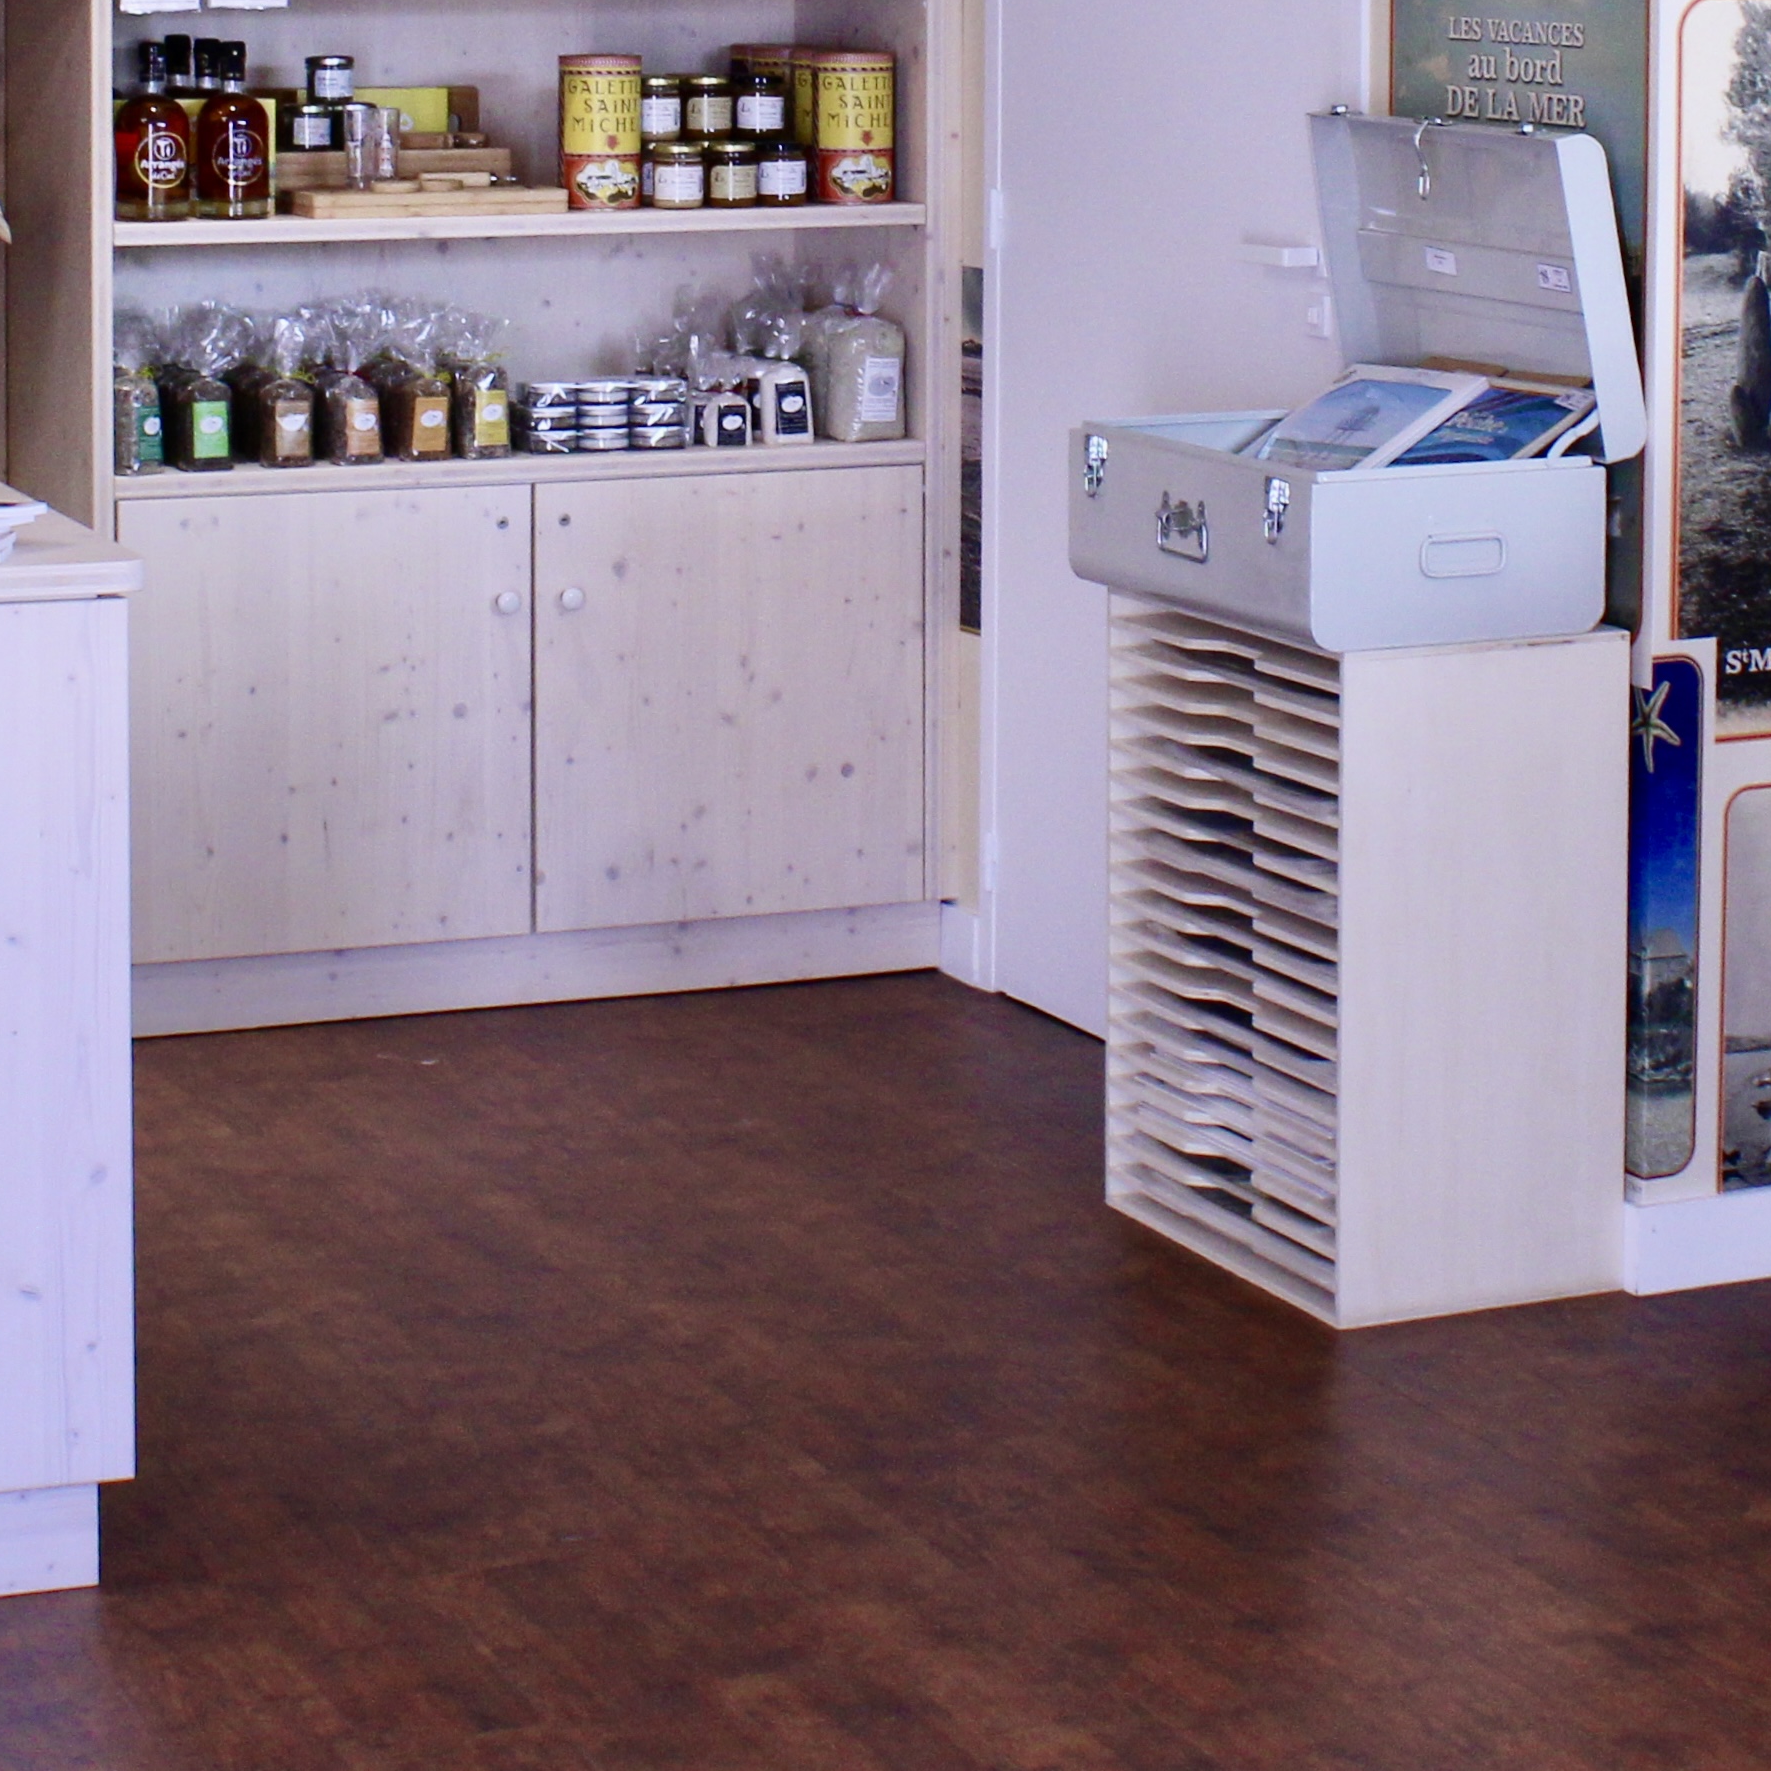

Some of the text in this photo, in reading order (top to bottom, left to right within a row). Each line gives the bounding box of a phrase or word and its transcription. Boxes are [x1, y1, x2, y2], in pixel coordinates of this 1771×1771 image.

[1448, 16, 1585, 47] LES VACANCES
[1468, 49, 1563, 86] au bord
[1446, 85, 1586, 127] DE LA MER
